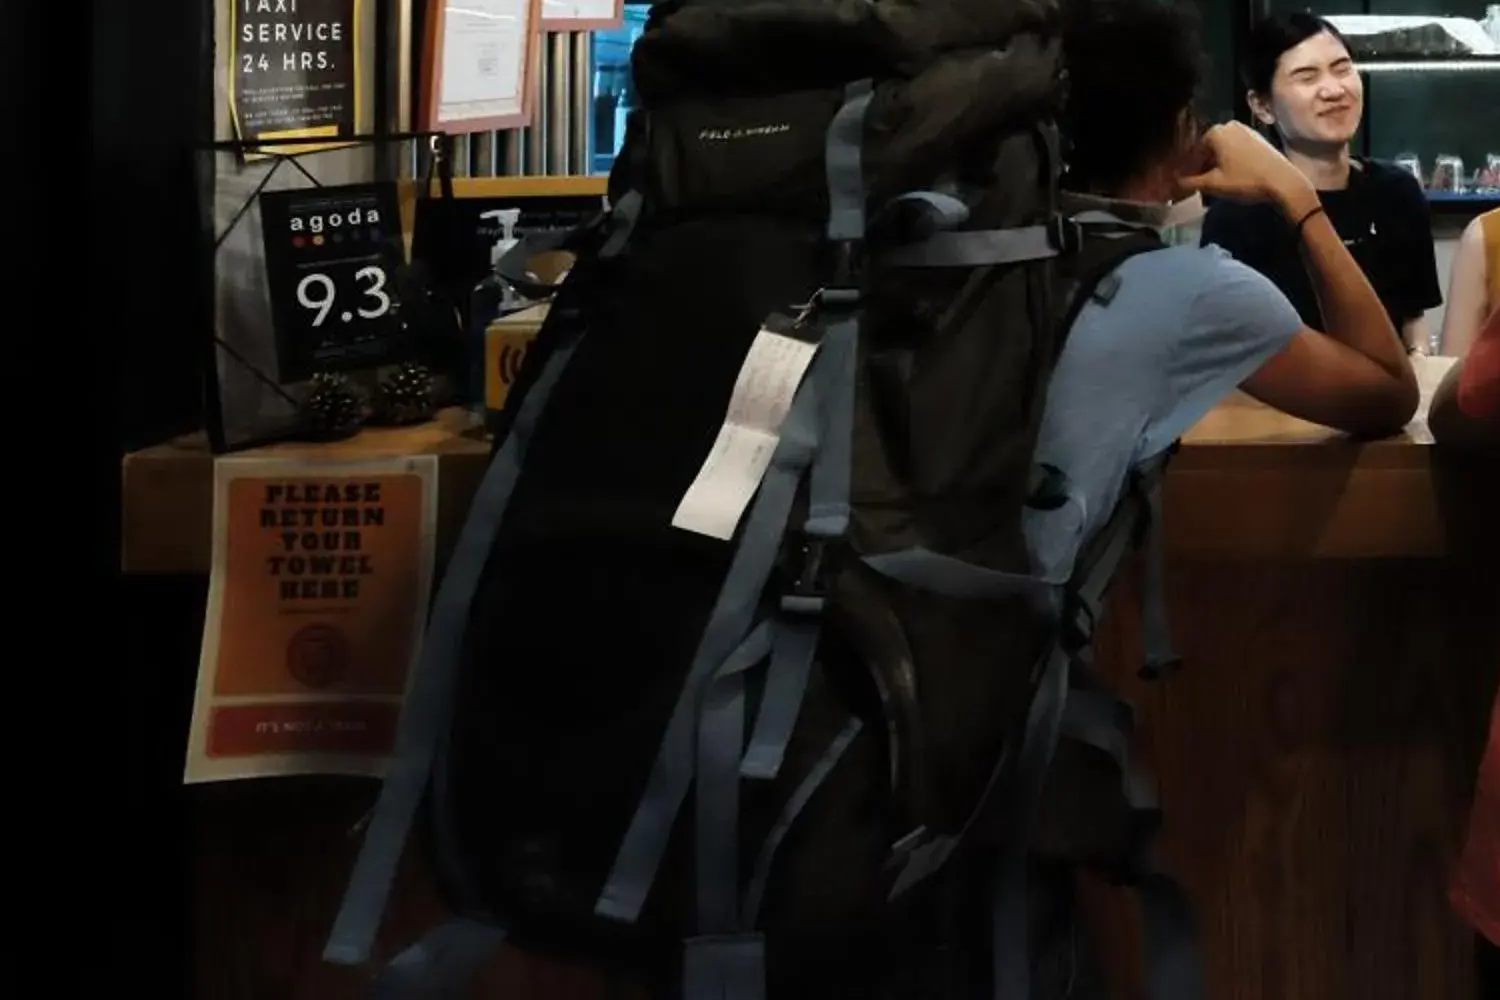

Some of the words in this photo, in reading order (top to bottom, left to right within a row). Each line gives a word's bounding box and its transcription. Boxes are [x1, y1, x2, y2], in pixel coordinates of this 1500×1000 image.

[242, 22, 342, 42] SERVICE
[243, 53, 270, 73] 24
[283, 51, 336, 71] HRS.
[289, 207, 381, 233] agoda
[296, 265, 391, 328] 9.3
[266, 483, 381, 502] PLEASE
[260, 507, 384, 527] RETURN
[280, 531, 361, 550] YOUR
[267, 554, 374, 576] TOWEL
[280, 579, 359, 600] HERE
